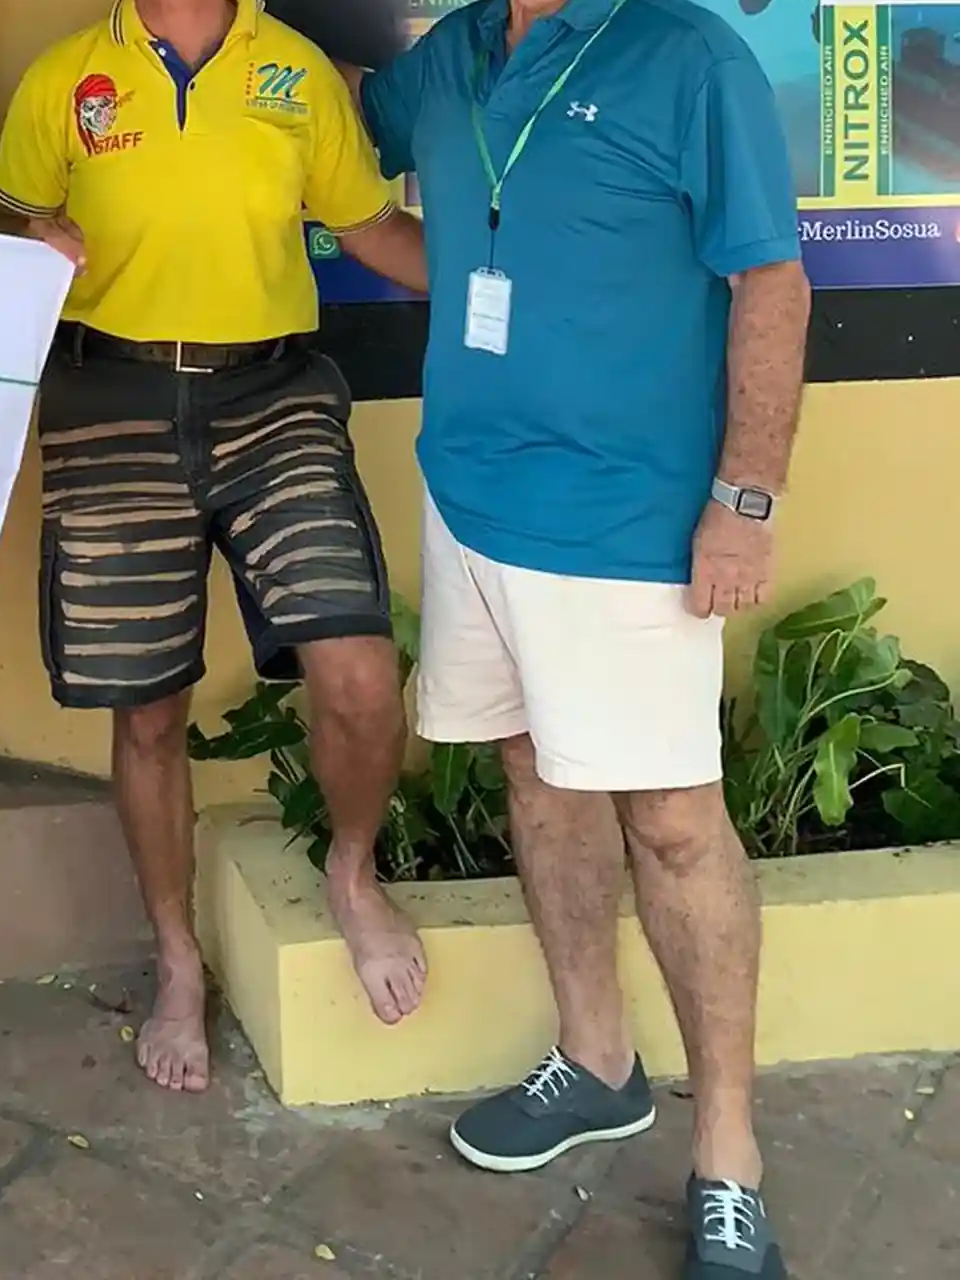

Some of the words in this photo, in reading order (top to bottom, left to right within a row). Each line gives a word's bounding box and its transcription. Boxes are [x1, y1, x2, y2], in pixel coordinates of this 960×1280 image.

[843, 20, 870, 181] NITROX
[95, 131, 144, 154] STAFF
[798, 219, 941, 241] MerlinSosua
